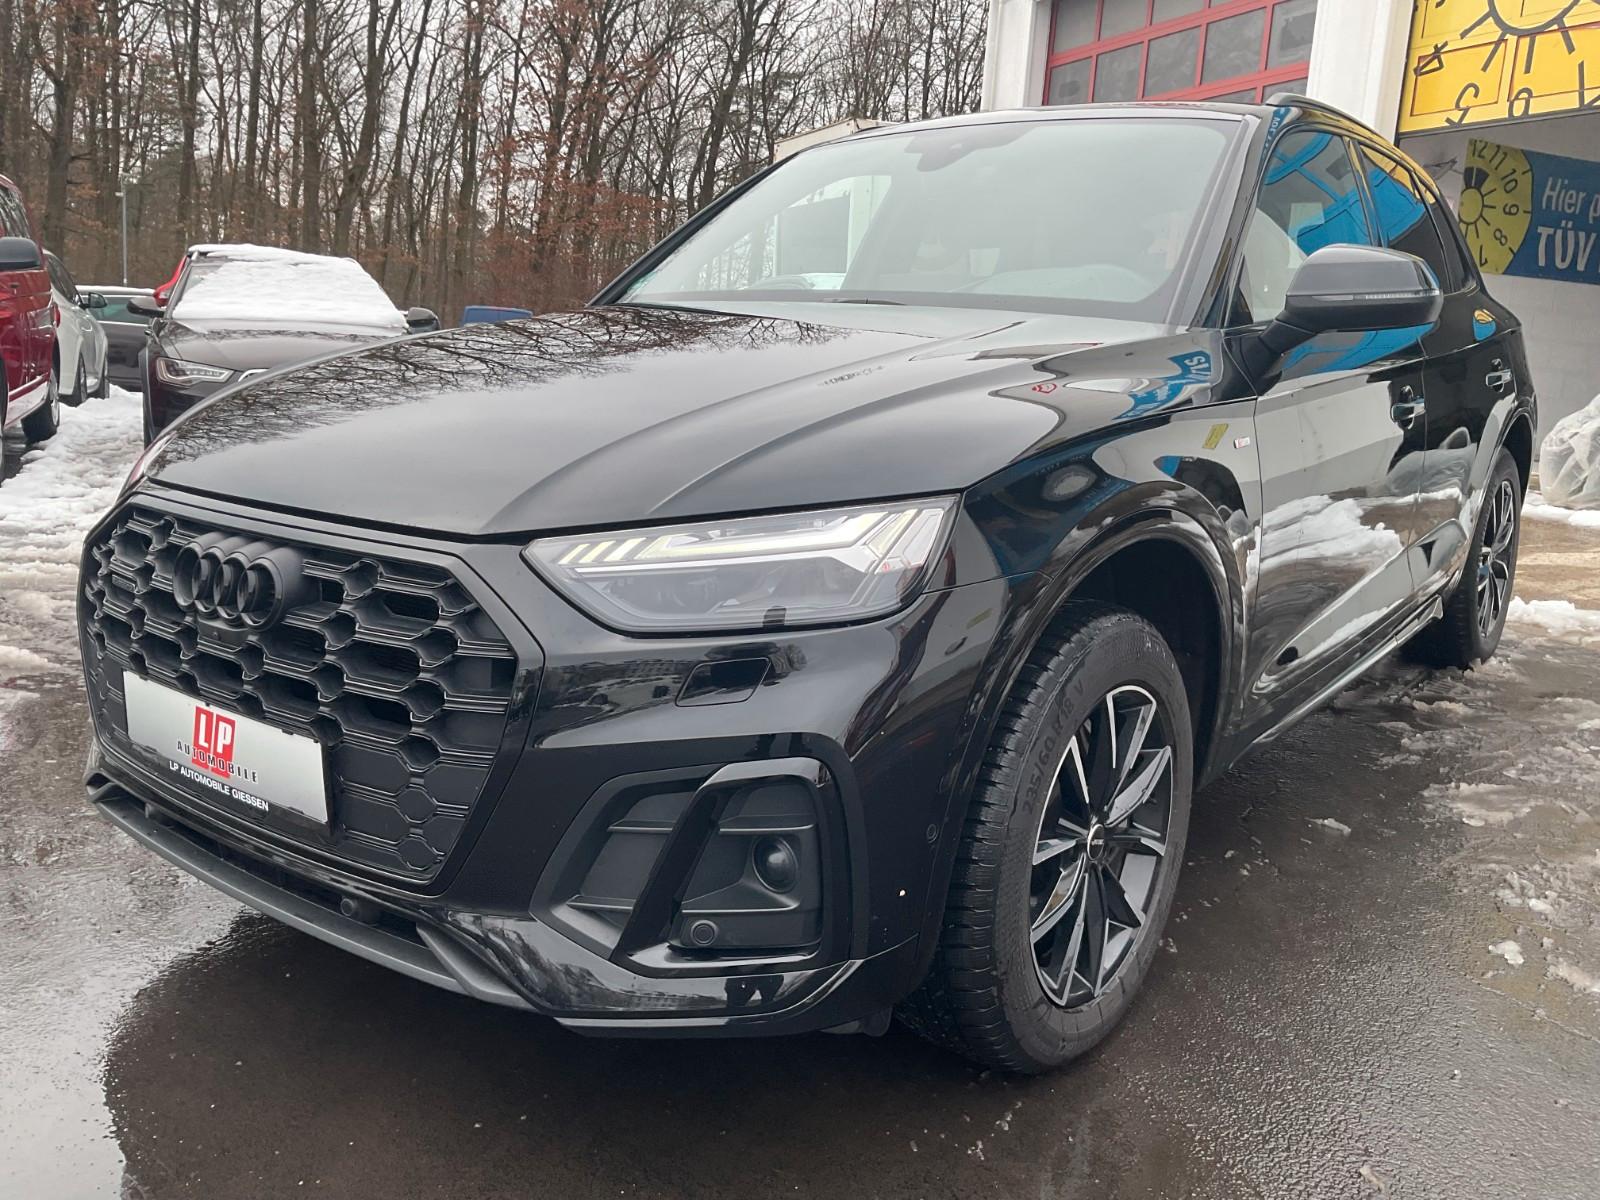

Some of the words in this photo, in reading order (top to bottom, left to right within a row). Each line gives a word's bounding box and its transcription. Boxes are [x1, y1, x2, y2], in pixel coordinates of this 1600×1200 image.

[1470, 138, 1489, 159] 12
[1489, 144, 1508, 170] 11
[1501, 168, 1519, 194] 10
[1542, 176, 1586, 215] Hier
[1503, 203, 1520, 216] 9
[1493, 228, 1508, 247] 8
[1537, 220, 1597, 271] TÜV
[1479, 244, 1489, 268] 7
[199, 713, 233, 753] LP
[177, 739, 258, 784] AUTOMOBILE
[169, 760, 179, 771] LP
[180, 766, 231, 796] AUTOMOBILE
[231, 788, 269, 812] GIESSEN
